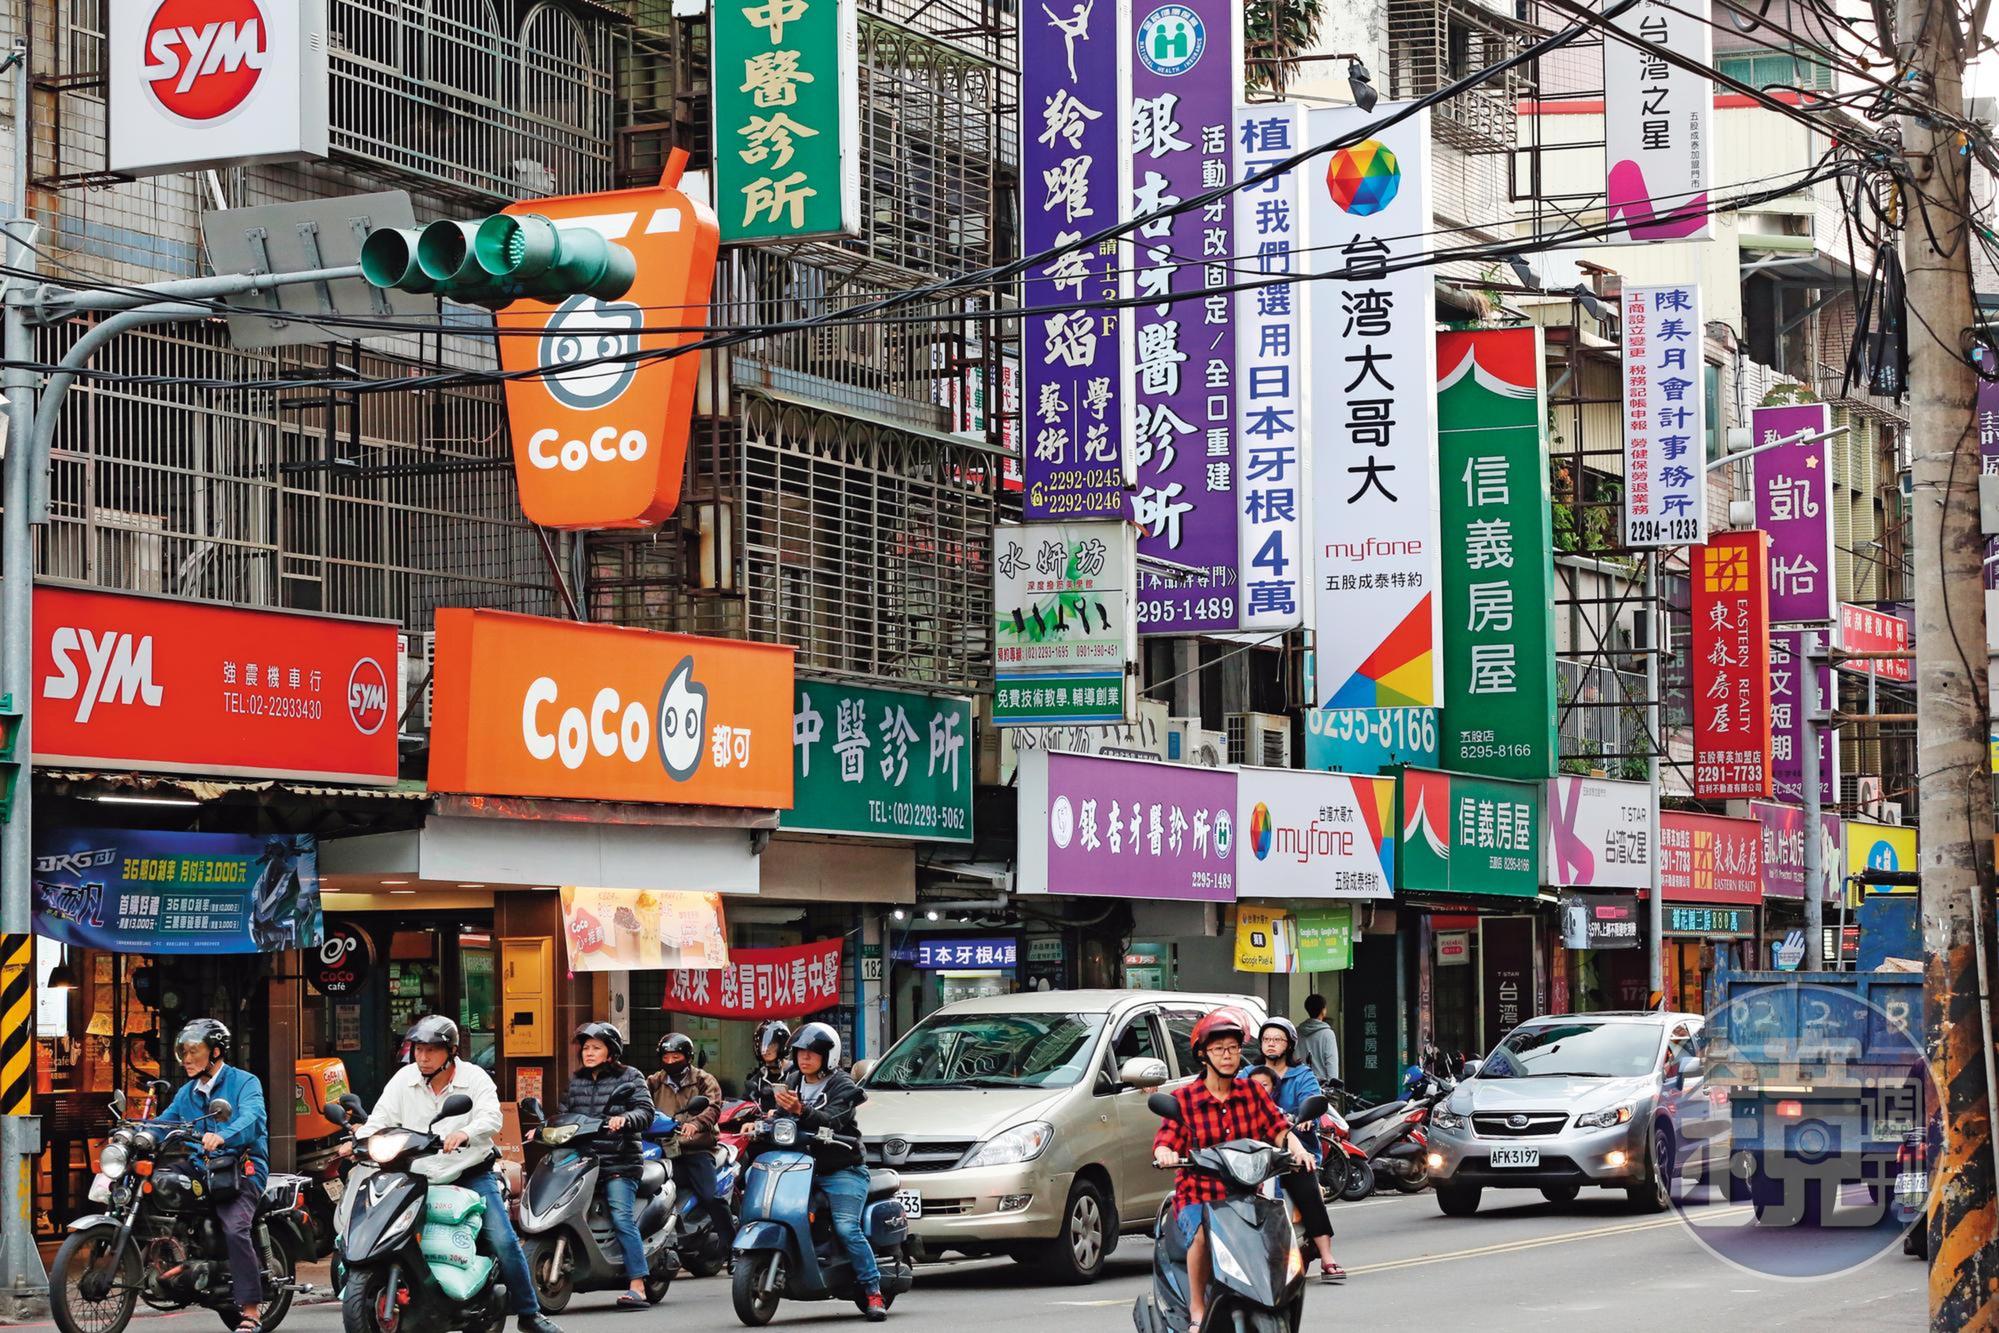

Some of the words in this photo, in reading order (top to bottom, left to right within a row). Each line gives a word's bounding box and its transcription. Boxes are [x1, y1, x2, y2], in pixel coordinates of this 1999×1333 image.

[141, 18, 267, 94] SYM
[737, 0, 819, 229] 中醫診所
[1131, 92, 1198, 550] 銀杏牙醫診所
[1628, 292, 1646, 358] 工商設立變更
[1240, 117, 1296, 616] 植牙我們選用日本牙根4萬
[1341, 233, 1398, 504] 台湾大哥大
[1629, 364, 1647, 431] 稅務記帳申報
[1655, 289, 1695, 517] 陳美月會計事務所
[1034, 382, 1069, 464] 藝術
[1083, 377, 1118, 462] 學苑
[528, 426, 648, 472] CoCo
[1049, 468, 1121, 491] 2292-0245
[1630, 437, 1649, 516] 勞健保勞退業務
[1049, 492, 1121, 513] 2292-0246
[1325, 537, 1422, 561] myfone
[1631, 519, 1698, 542] 2294-1233
[1769, 473, 1819, 597] 凱怡
[1325, 572, 1423, 591] 五股成泰特約
[1461, 456, 1517, 695] 信義房屋
[1736, 599, 1749, 668] EASTERN
[43, 626, 164, 723] SYM
[223, 661, 322, 692] 強震機車行
[1706, 601, 1737, 733] 東森房屋
[223, 692, 323, 721] TEL:02-22933430
[349, 682, 386, 716] SYM
[1739, 678, 1751, 734] REALTY
[522, 676, 650, 770] CoCo
[793, 692, 964, 793] 中醫診所
[1460, 730, 1494, 743] 五股店
[711, 724, 752, 769] 都可
[1460, 744, 1531, 758] 8295-8166
[1699, 751, 1762, 764] 五股菁英加盟店
[1698, 766, 1763, 782] 2291-7733
[869, 800, 965, 830] TEL:(02)2293-5062
[1078, 798, 1211, 860] 銀杏牙醫診所
[1458, 797, 1530, 851] 信義房屋
[1621, 806, 1626, 820] T
[1628, 807, 1647, 822] STAR
[1276, 820, 1354, 863] myfone
[1605, 829, 1647, 864] 台湾之星
[1714, 833, 1757, 876] 東森房屋
[1192, 871, 1232, 889] 2295-1489
[1335, 871, 1379, 891] 五股成泰特約
[1714, 878, 1737, 891] EASTERN
[1739, 880, 1756, 892] REALTY
[571, 919, 589, 934] CoCo
[320, 971, 354, 982] CoCo
[721, 951, 838, 1009] 感冒可以看中醫
[865, 961, 882, 977] 182
[1241, 954, 1258, 966] Google
[328, 982, 346, 991] café
[1364, 1004, 1378, 1069] 信義房屋
[1491, 1149, 1539, 1166] AFK-3197
